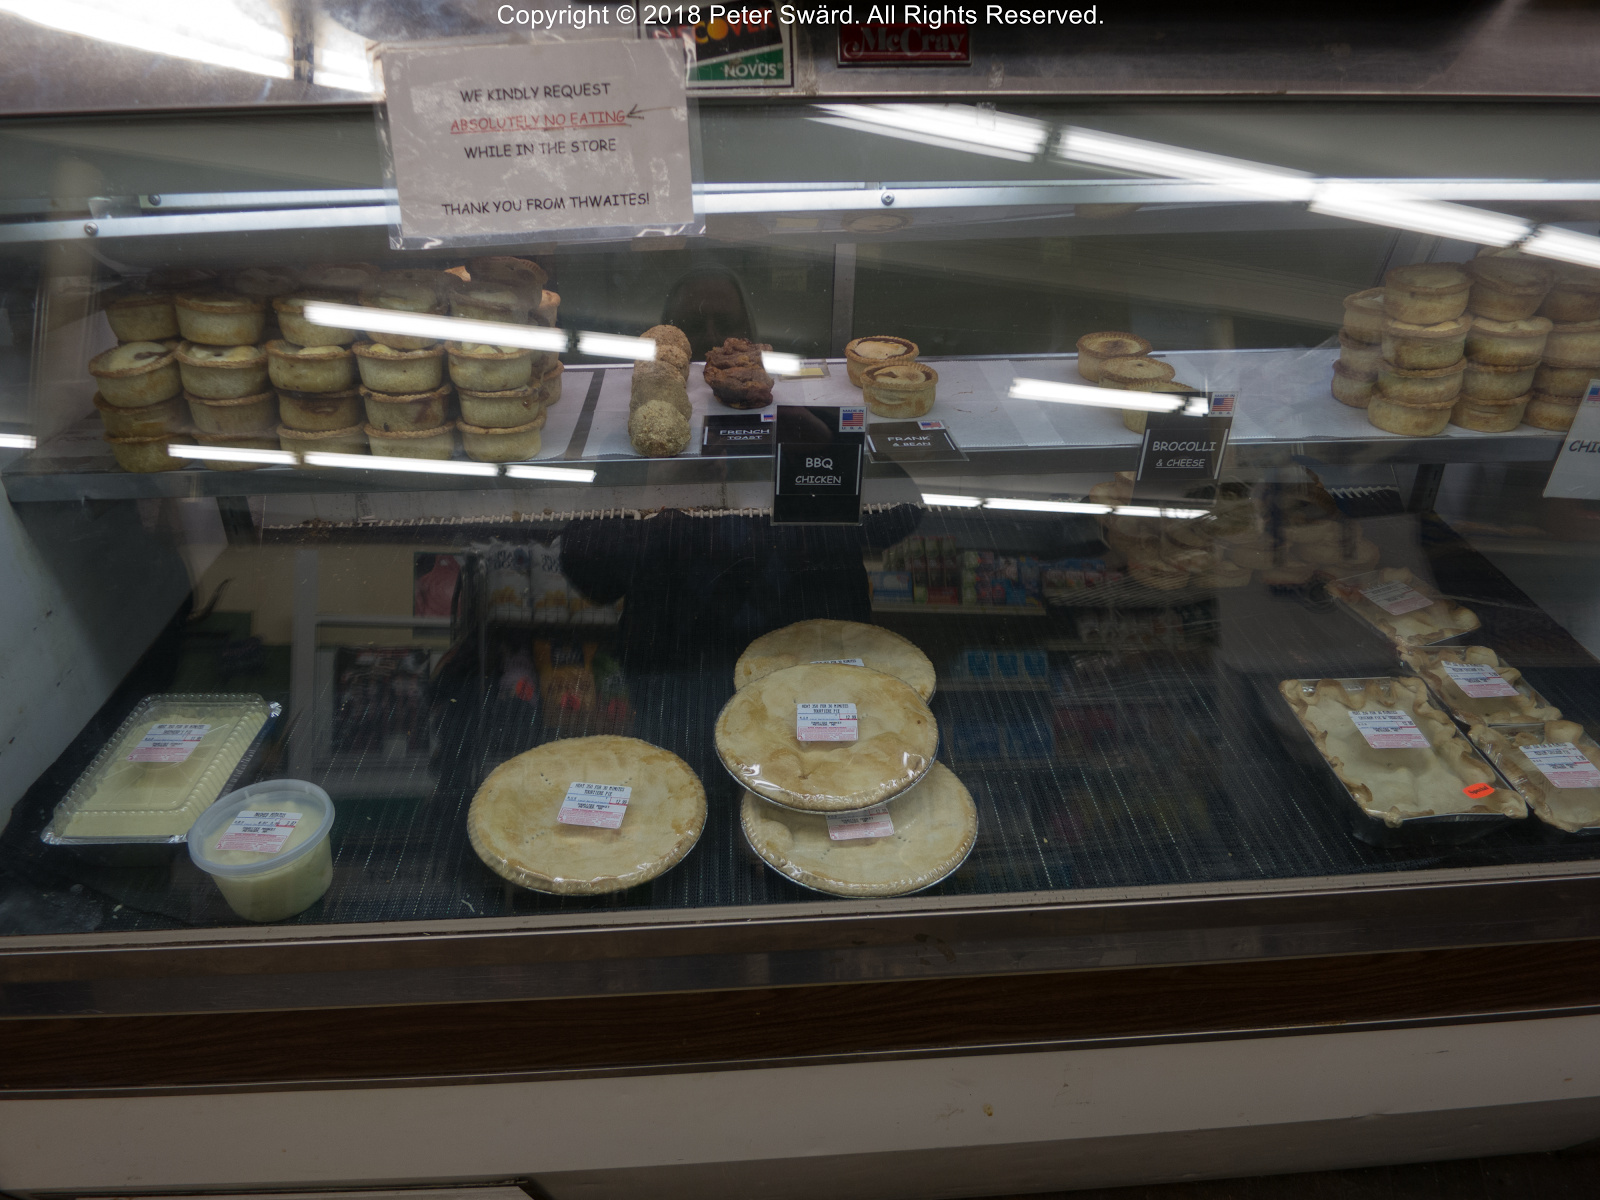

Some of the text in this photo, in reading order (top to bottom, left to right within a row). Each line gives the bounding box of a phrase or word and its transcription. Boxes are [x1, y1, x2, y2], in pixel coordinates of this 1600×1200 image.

[844, 26, 966, 58] McCray
[724, 63, 777, 77] NOVUS
[460, 82, 611, 102] WE KINDLY REQUEST
[451, 110, 626, 132] ABSOLUTELY NO EATING
[464, 138, 616, 159] WHILE IN THE STORE
[441, 192, 650, 215] THANK YOU FROM THWAITES!
[1152, 441, 1217, 452] BROCOLLI
[1568, 440, 1600, 453] CHI
[805, 457, 834, 471] BBQ
[1166, 458, 1206, 467] CHEESE
[795, 475, 842, 485] CHICKEN
